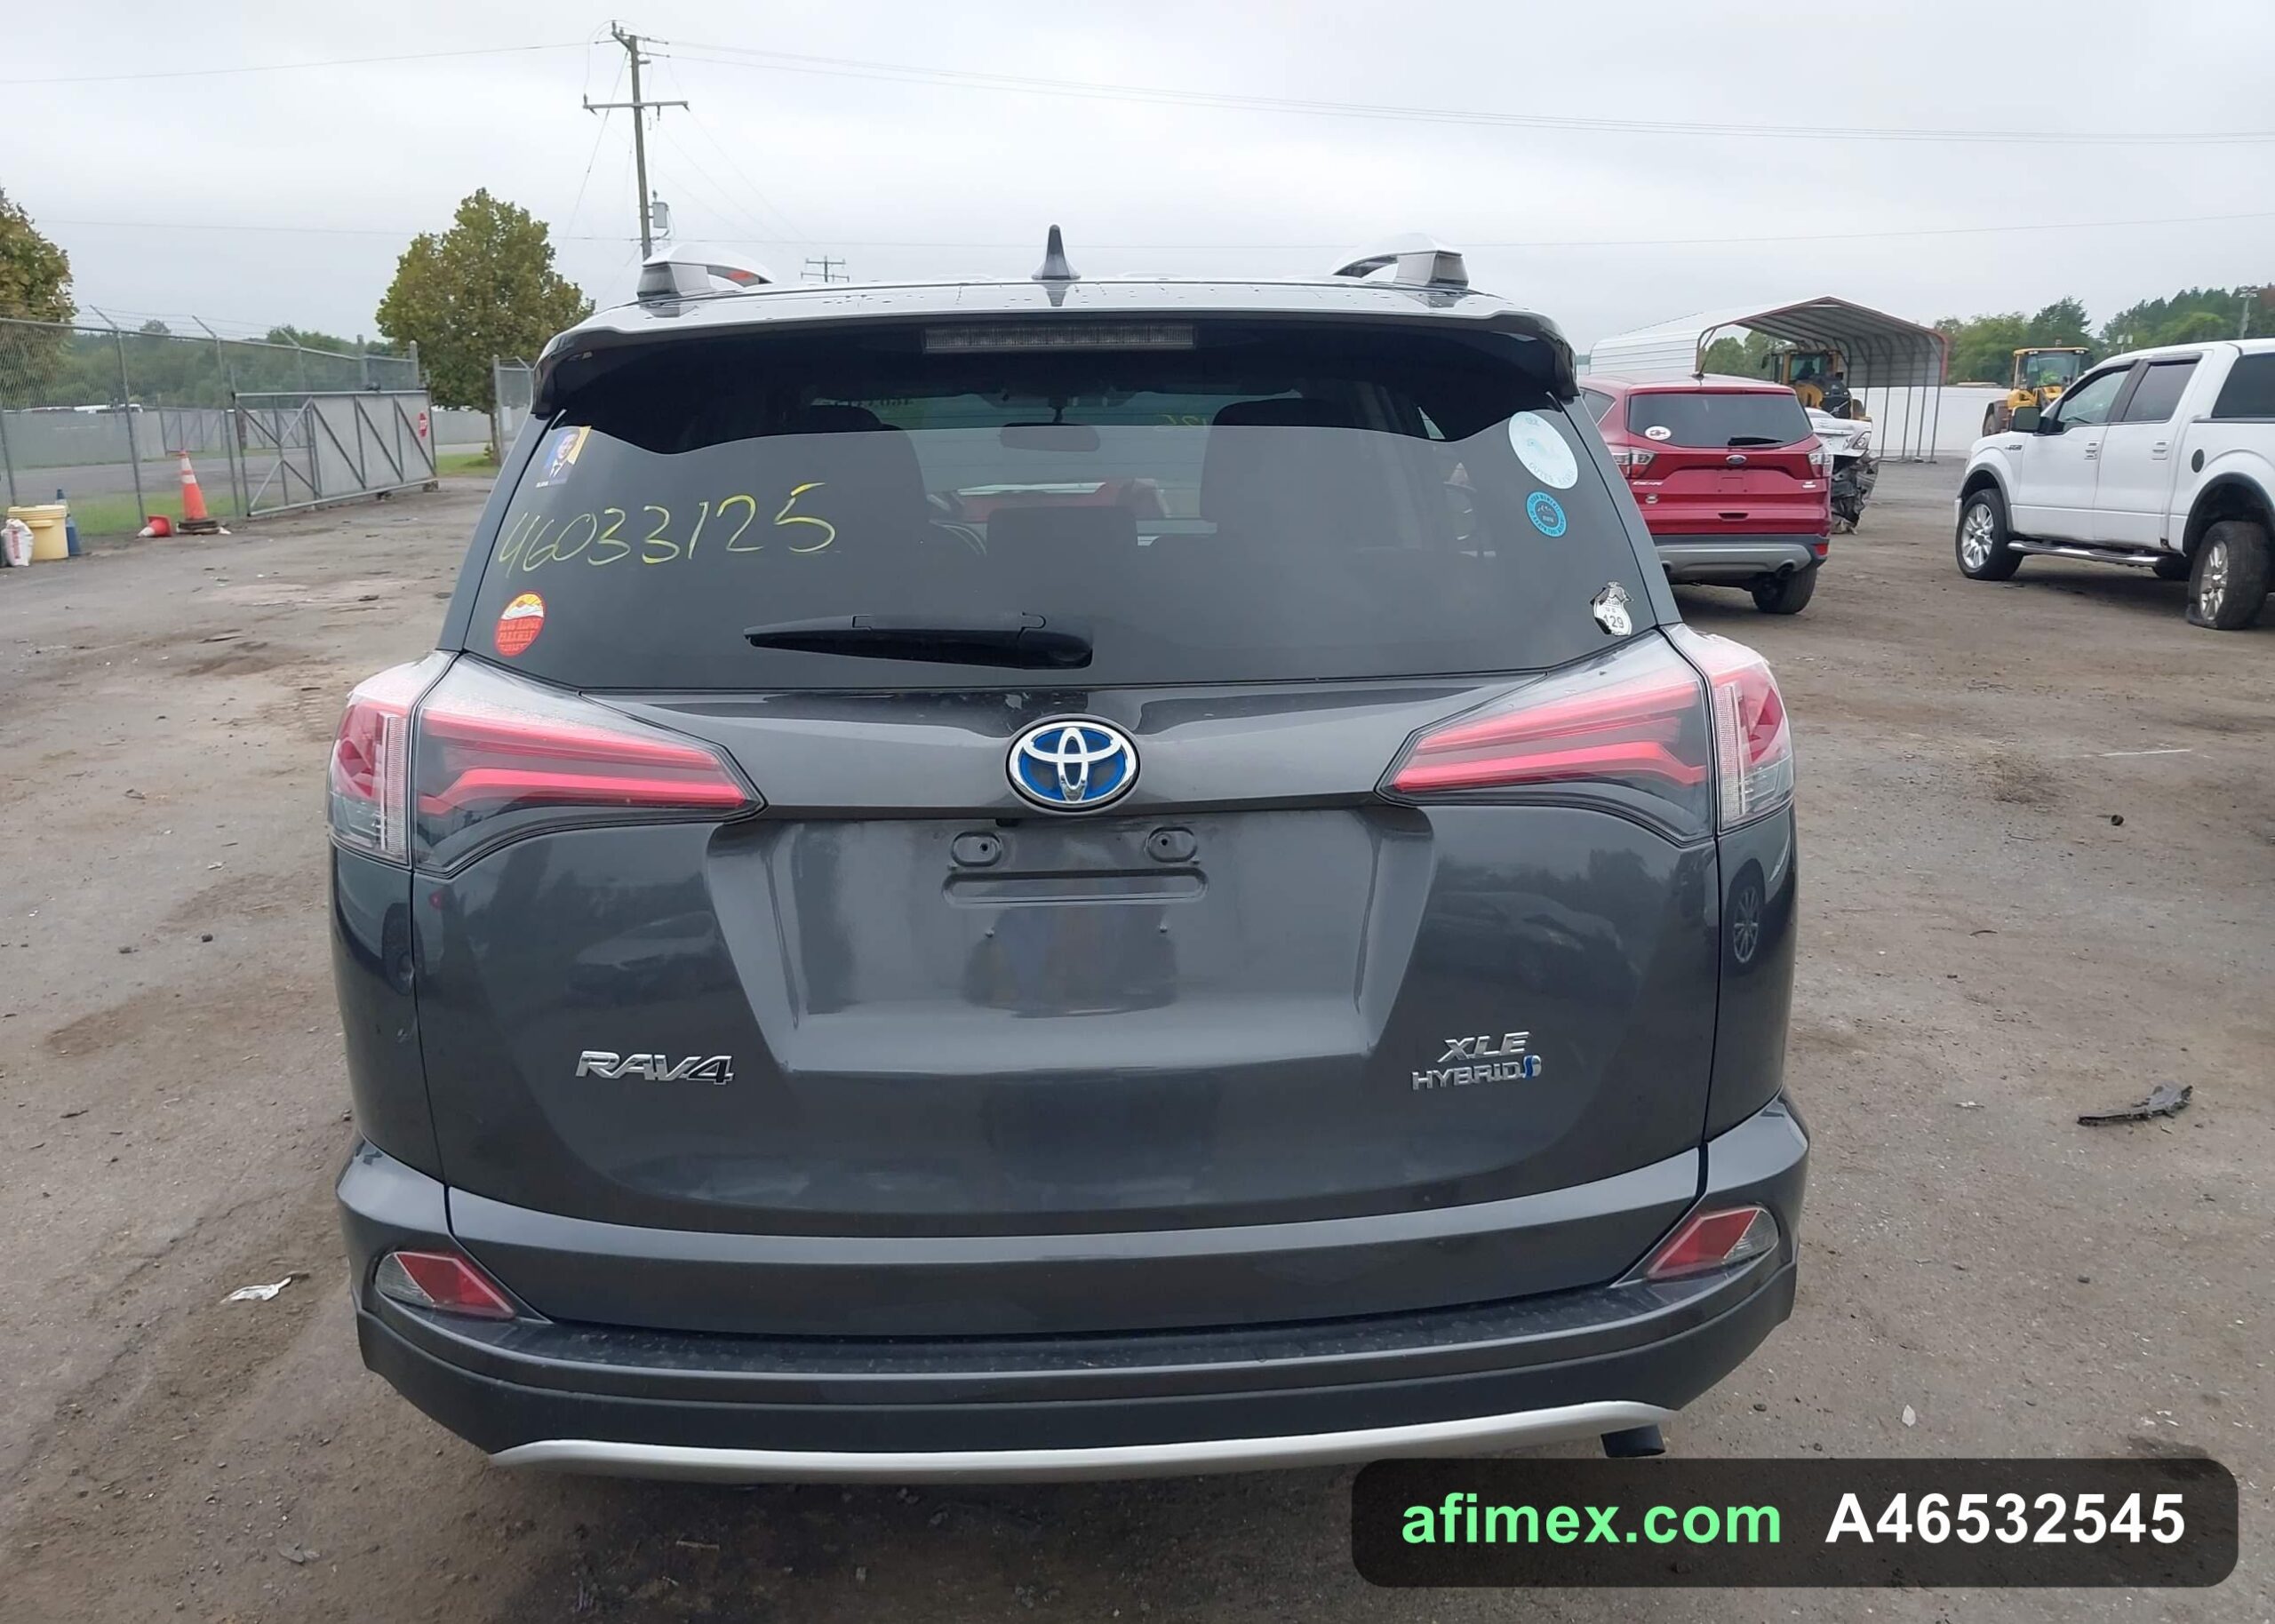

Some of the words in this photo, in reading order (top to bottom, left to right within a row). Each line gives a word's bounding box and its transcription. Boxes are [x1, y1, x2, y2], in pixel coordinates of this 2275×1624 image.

[499, 482, 835, 578] 46033125
[1603, 614, 1624, 629] 129
[1437, 1031, 1529, 1063] XLE
[576, 1050, 734, 1085] RAV4
[1412, 1062, 1521, 1090] HYBRID
